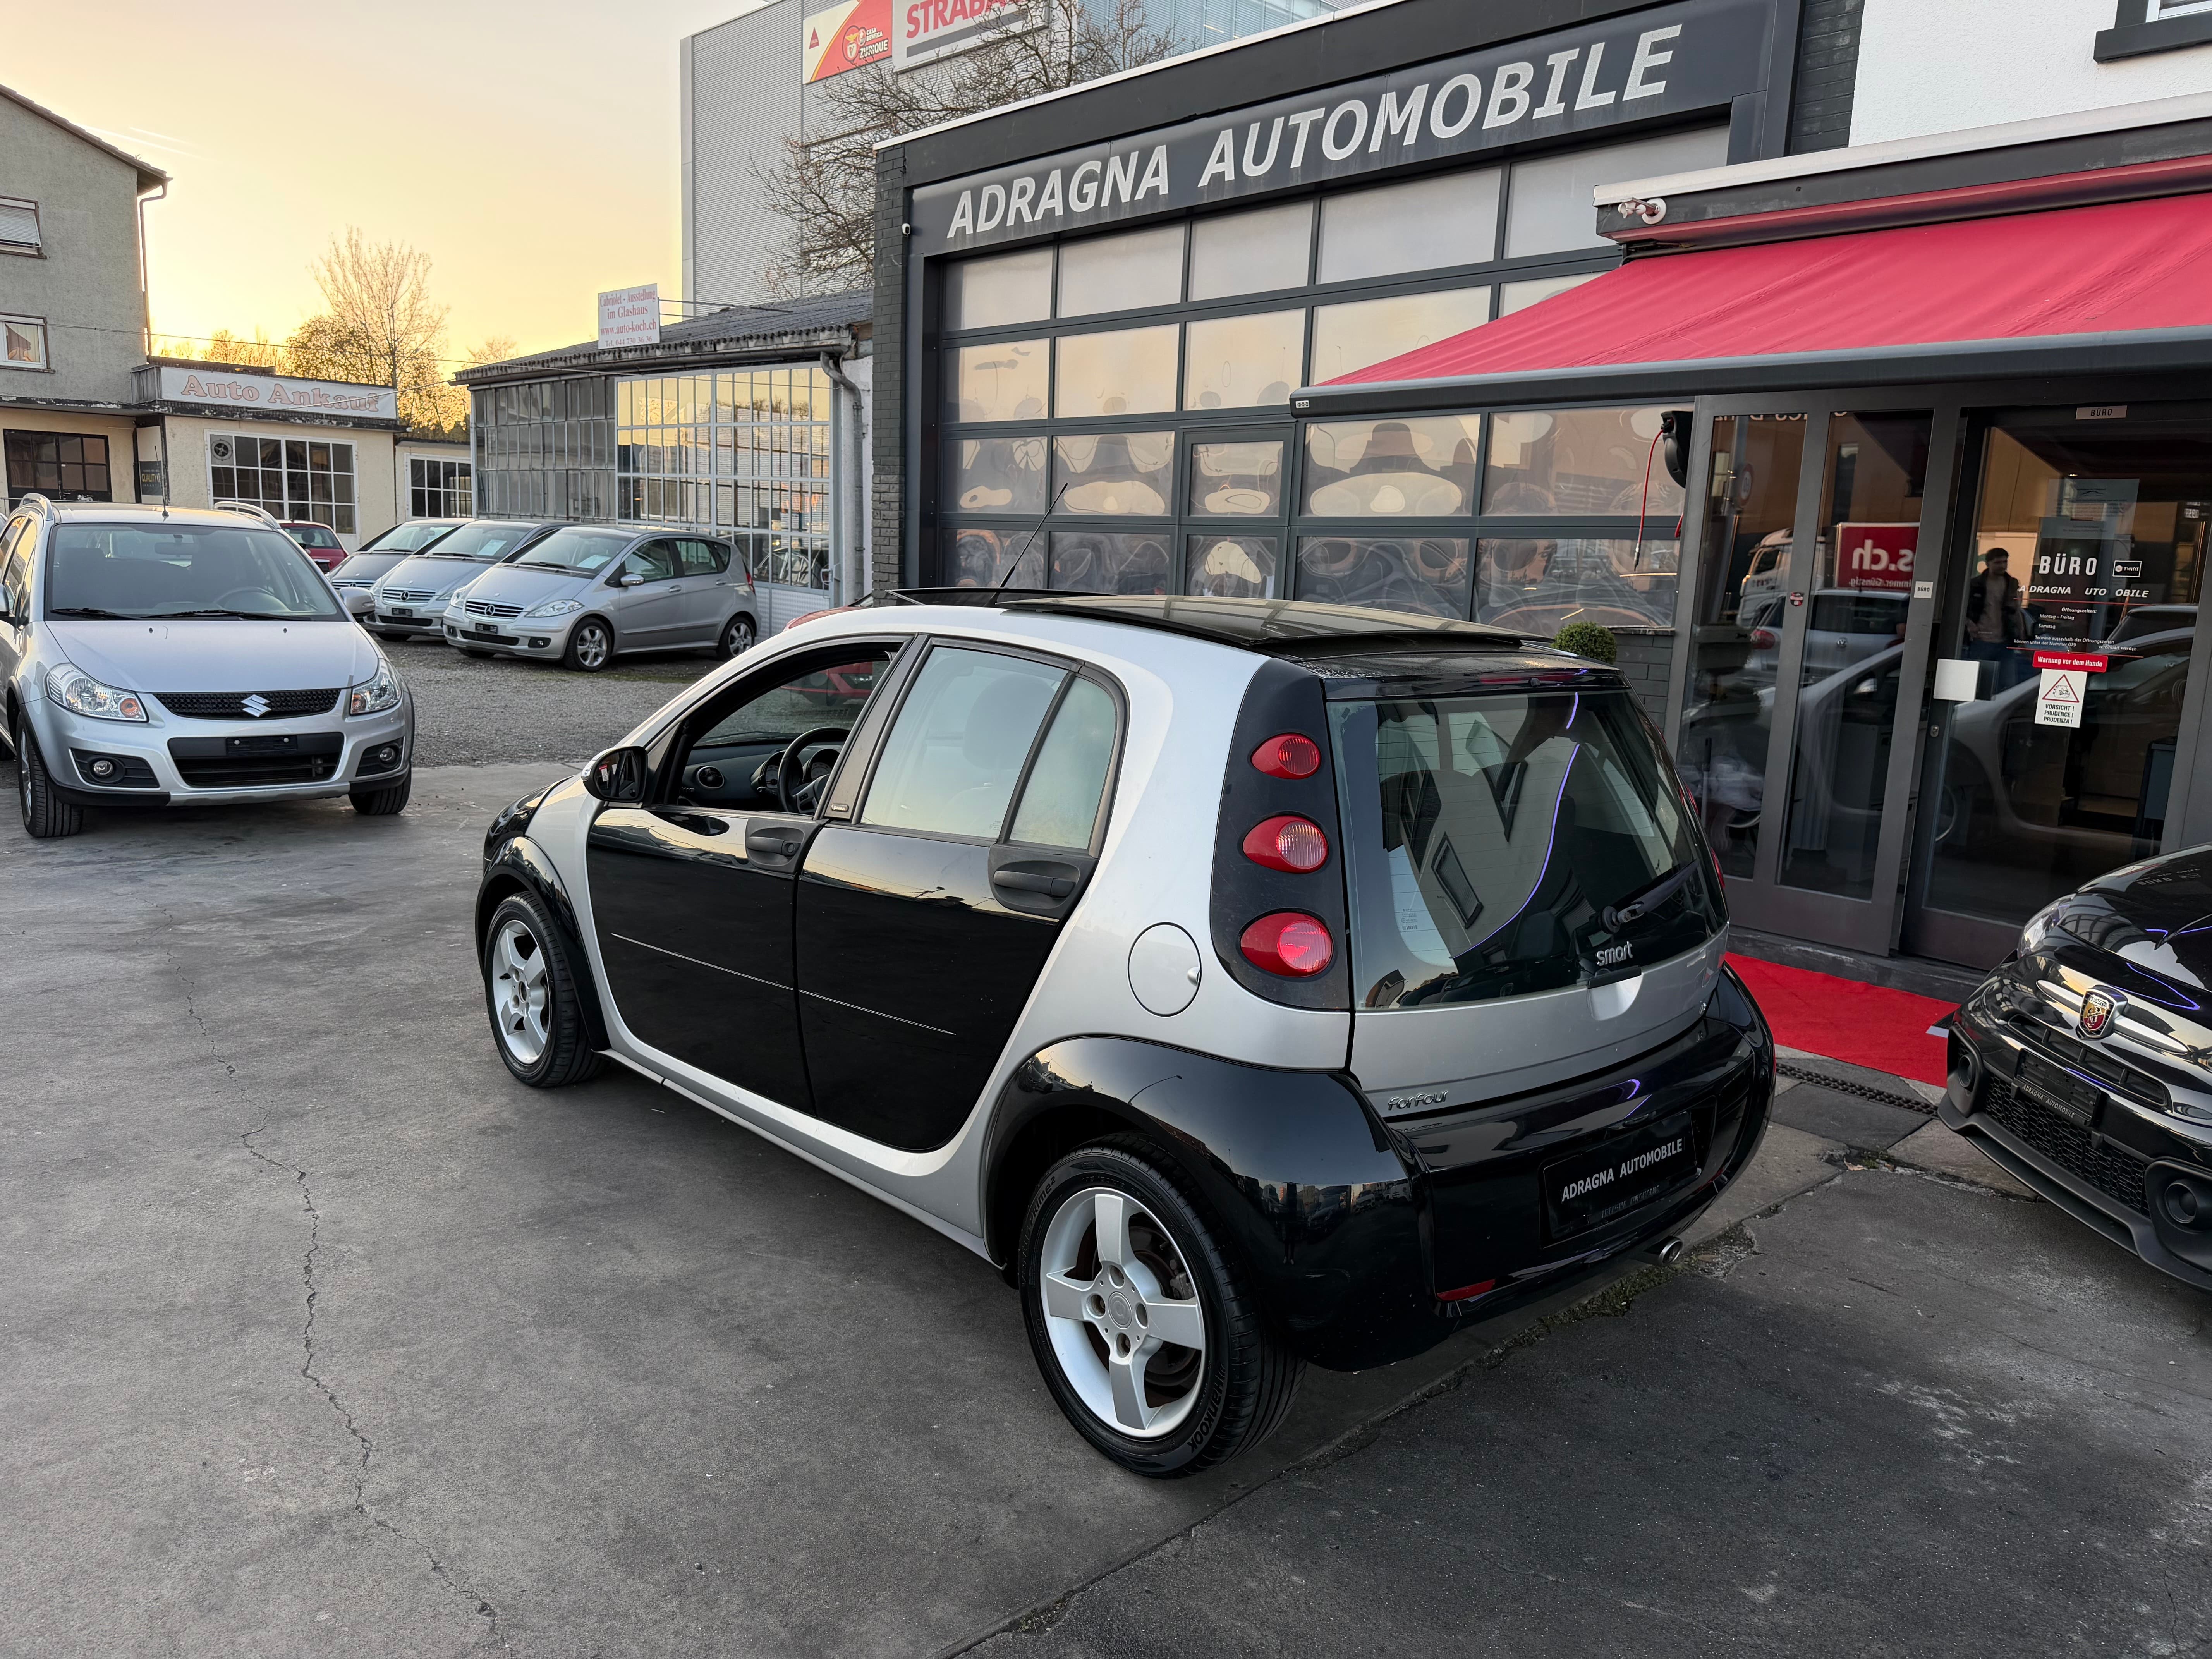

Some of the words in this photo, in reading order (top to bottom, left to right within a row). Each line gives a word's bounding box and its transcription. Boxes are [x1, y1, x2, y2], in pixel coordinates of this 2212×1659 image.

[946, 145, 1168, 238] ADRAGNA
[1197, 24, 1682, 187] AUTOMOBILE
[600, 293, 622, 307] Cabriolet
[627, 289, 656, 302] Ausstellung
[608, 308, 615, 319] im
[618, 305, 648, 318] Glashaus
[600, 318, 656, 335] www.auto-koch.ch
[181, 375, 259, 401] Auto
[268, 383, 380, 412] Ankauf
[2091, 408, 2112, 416] BÜRO
[2039, 553, 2097, 575] BÜRO
[2038, 656, 2061, 665] Warnung
[1596, 941, 1633, 966] smart
[2022, 1085, 2044, 1100] ADRAGNA
[2045, 1099, 2075, 1118] AUTOMOBILE
[1561, 1168, 1614, 1202] ADRAGNA
[1620, 1138, 1682, 1178] AUTOMOBILE
